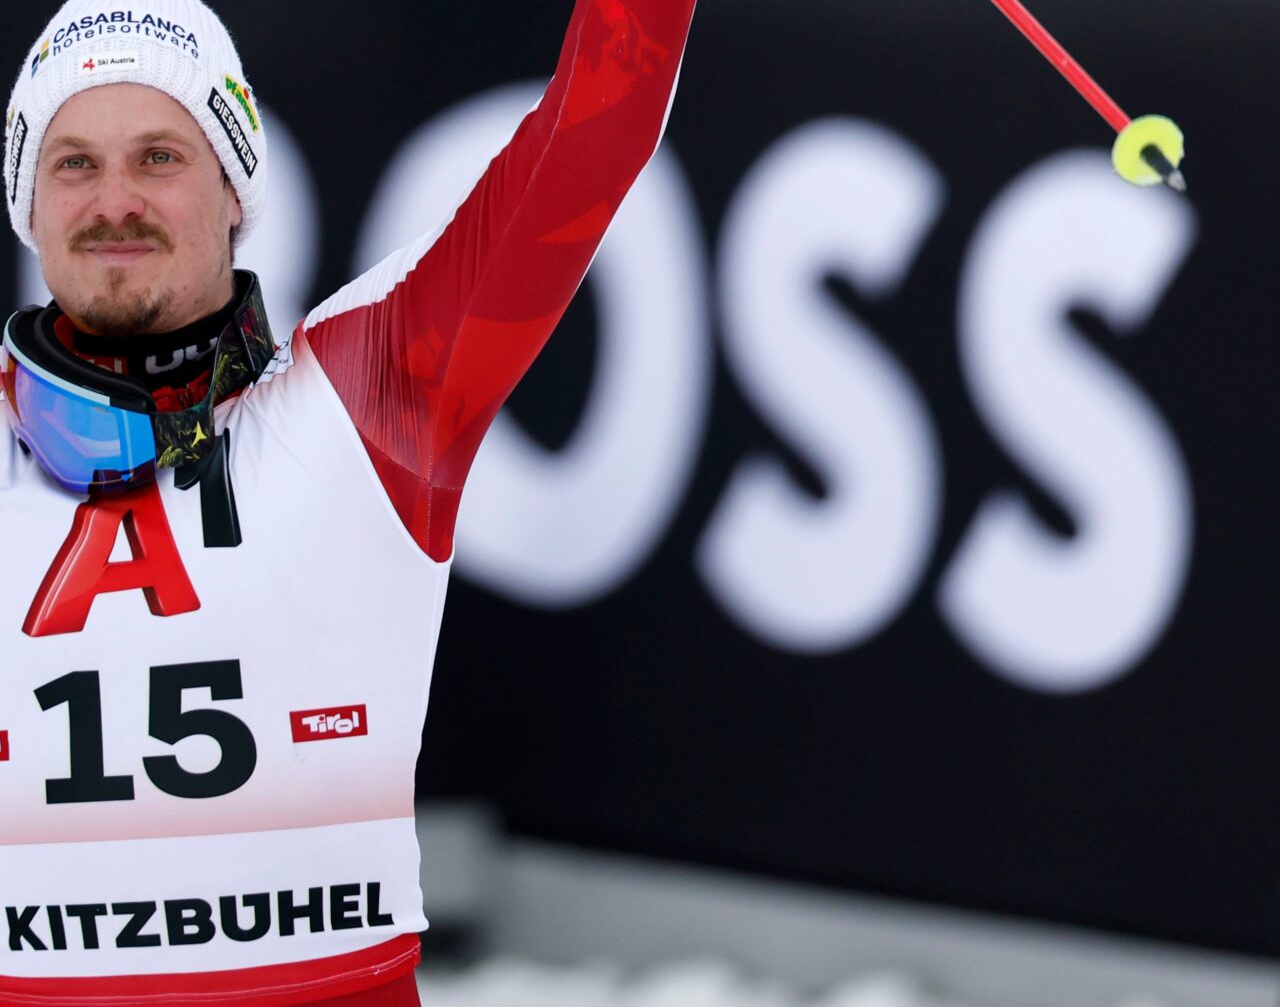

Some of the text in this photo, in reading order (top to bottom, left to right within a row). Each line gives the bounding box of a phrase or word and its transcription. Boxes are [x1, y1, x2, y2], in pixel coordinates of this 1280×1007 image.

[53, 10, 199, 49] CASABLANCA
[53, 22, 199, 59] hotelsoftware
[97, 56, 135, 66] Ski Austria
[212, 94, 256, 172] GIESSWEIN
[33, 658, 257, 805] 15
[301, 710, 360, 734] Tirol
